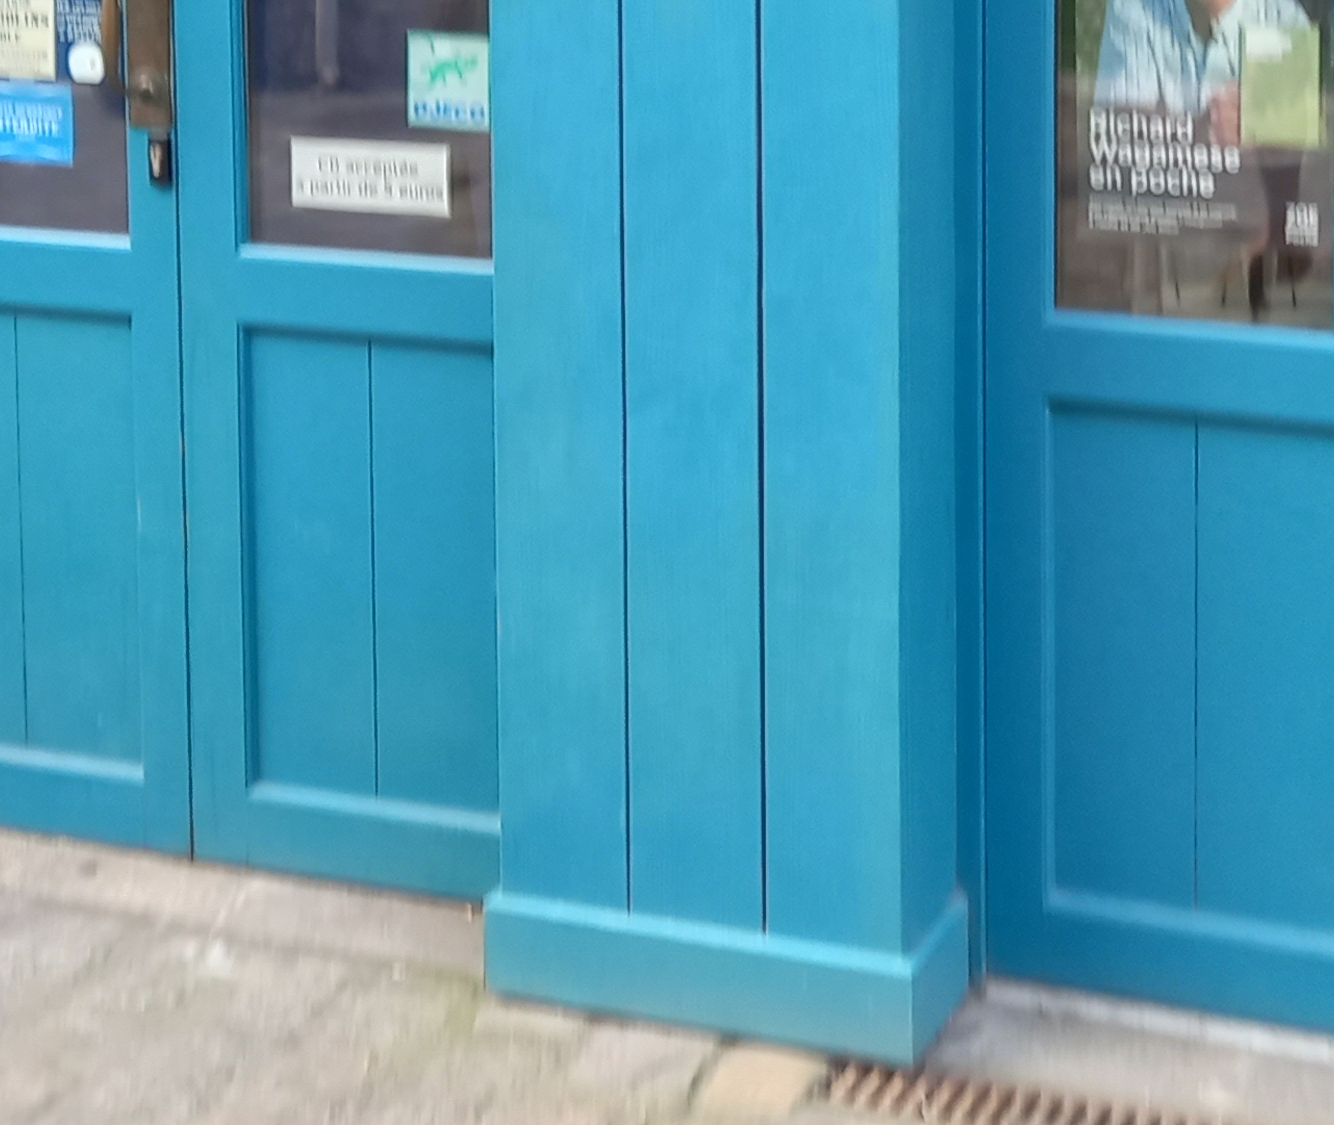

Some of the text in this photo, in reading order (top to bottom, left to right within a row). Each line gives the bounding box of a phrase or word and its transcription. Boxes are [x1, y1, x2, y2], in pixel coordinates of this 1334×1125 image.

[1090, 108, 1194, 145] Richard
[317, 156, 340, 173] CB
[1089, 162, 1216, 200] en poche
